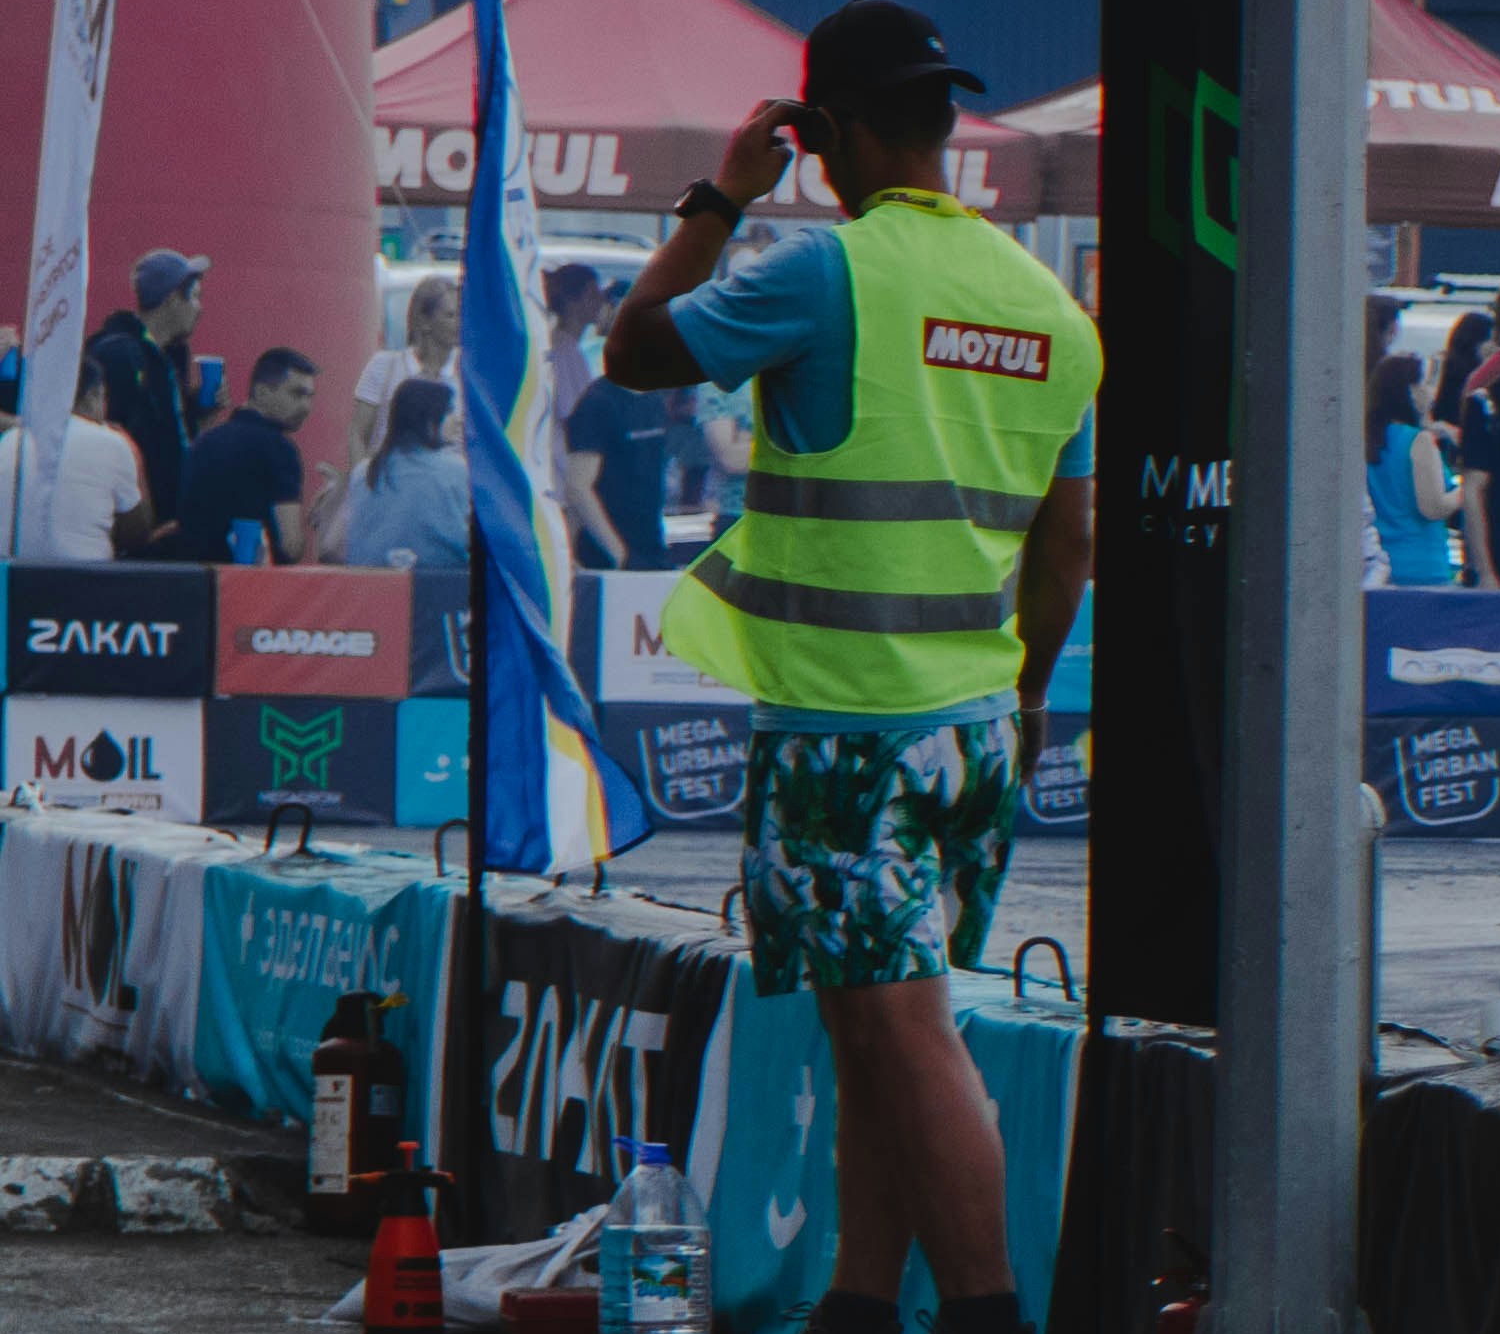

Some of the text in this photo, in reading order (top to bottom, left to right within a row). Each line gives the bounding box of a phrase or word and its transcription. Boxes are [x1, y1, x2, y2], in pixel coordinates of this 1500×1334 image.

[374, 127, 631, 196] MOUL
[926, 325, 1047, 374] MOTUL
[27, 618, 178, 657] ZAKAT
[251, 628, 376, 658] GARAGE
[656, 719, 728, 748] MEGA
[1410, 725, 1481, 756] MEGA
[660, 742, 749, 776] URBAN
[1413, 749, 1499, 782] URBAN
[664, 773, 725, 802] FEST
[1417, 779, 1478, 809] FEST
